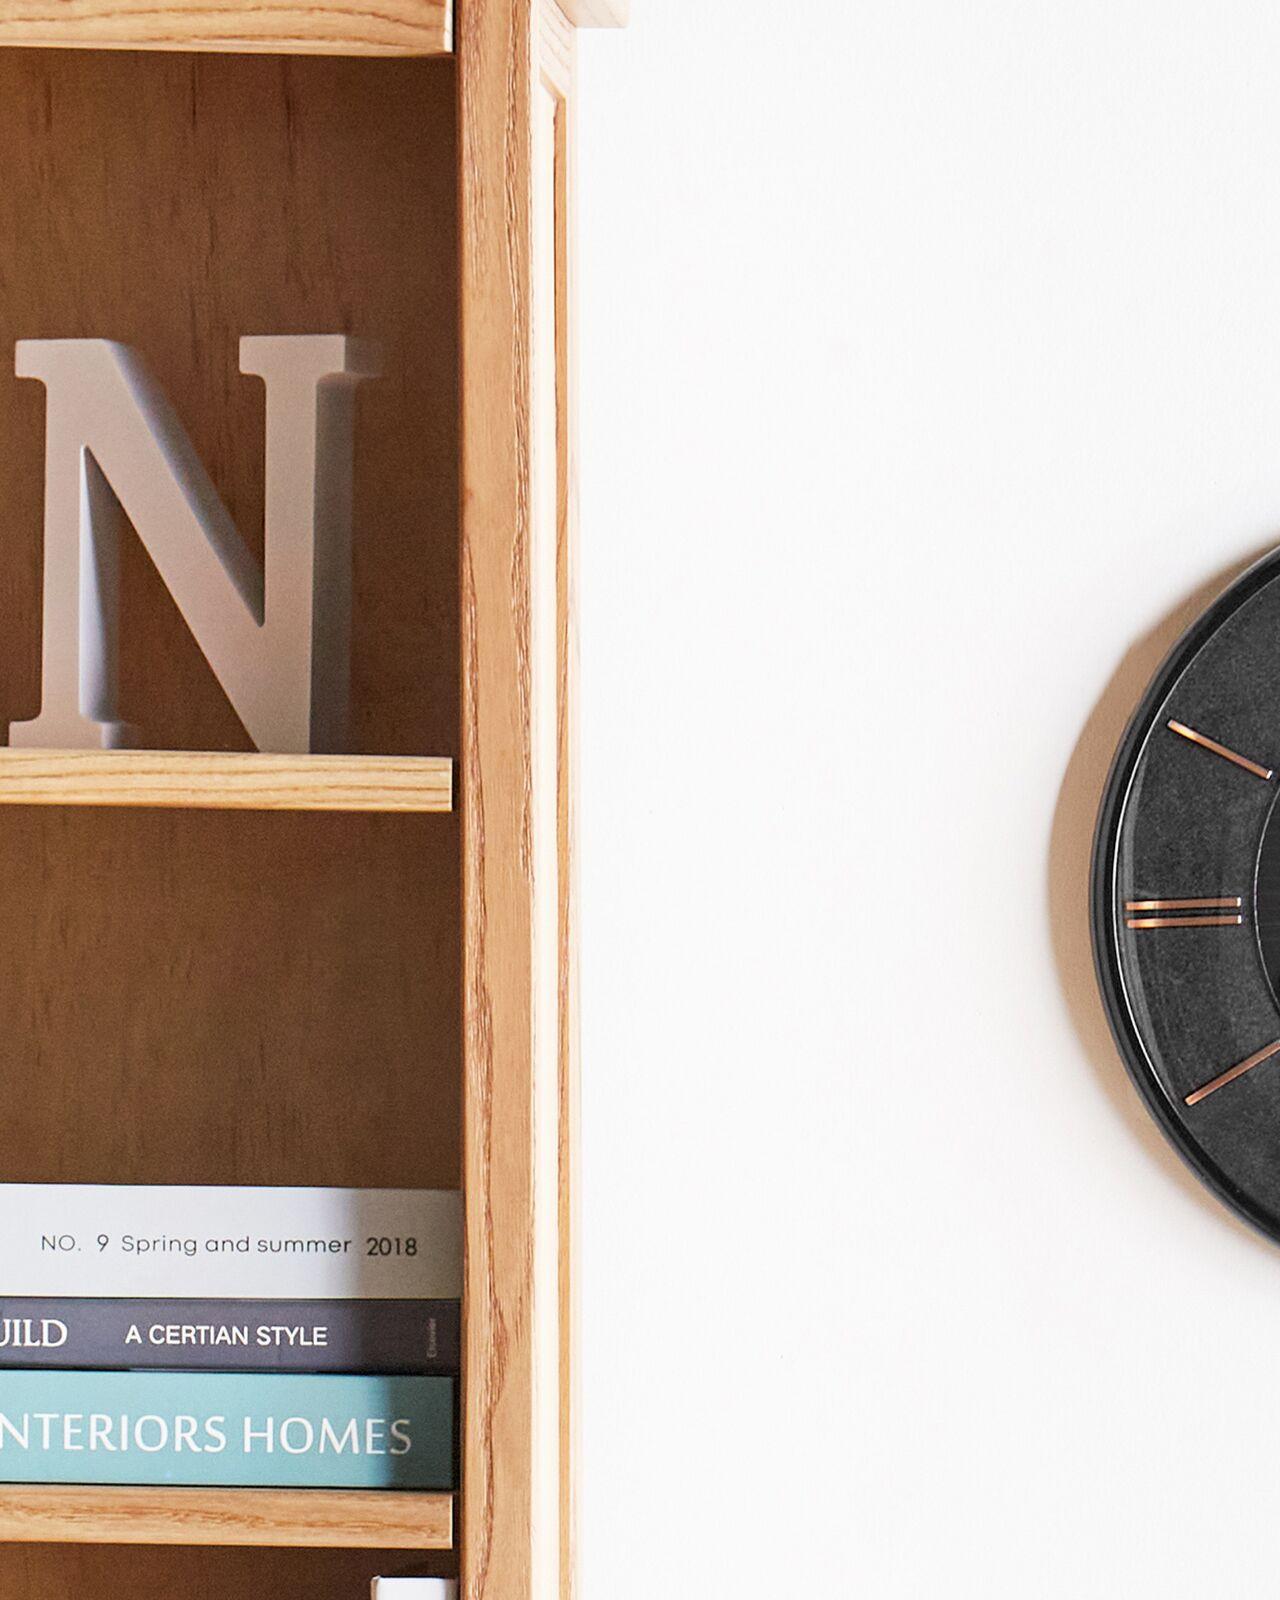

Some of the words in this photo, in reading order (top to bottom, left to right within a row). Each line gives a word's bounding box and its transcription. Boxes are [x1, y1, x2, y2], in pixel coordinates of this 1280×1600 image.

[41, 1234, 82, 1252] NO.
[97, 1234, 109, 1252] 9
[122, 1235, 197, 1256] Spring
[205, 1236, 250, 1253] and
[257, 1238, 352, 1254] summer
[366, 1237, 418, 1257] 2018
[125, 1325, 143, 1344] A
[149, 1325, 249, 1346] CERTIAN
[256, 1326, 328, 1346] STYLE
[0, 1412, 227, 1453] NTERIORS
[243, 1416, 412, 1455] HOMES
